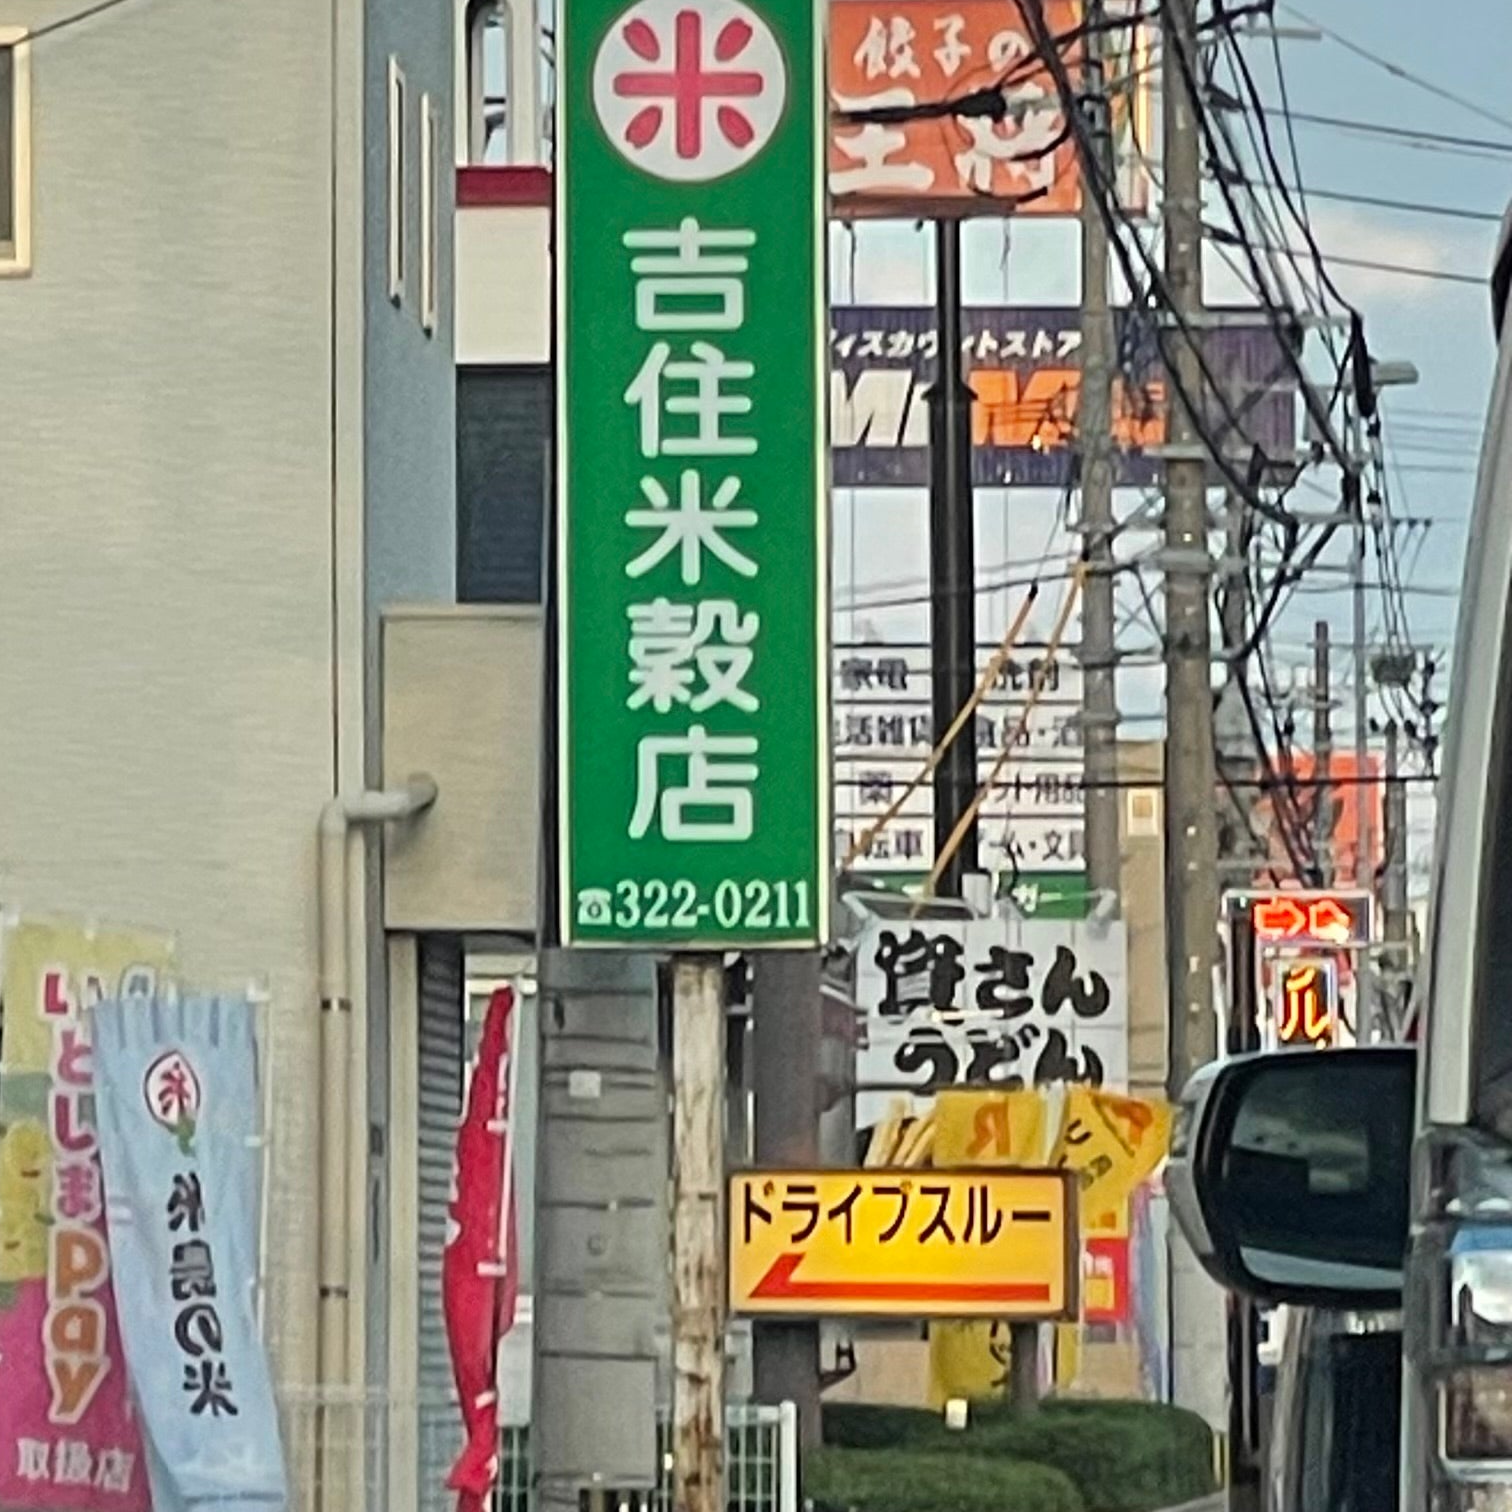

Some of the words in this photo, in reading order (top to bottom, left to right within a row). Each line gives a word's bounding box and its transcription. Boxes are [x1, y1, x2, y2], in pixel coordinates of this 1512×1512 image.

[622, 216, 760, 844] 吉住米穀店
[875, 928, 1110, 1026] 資さん
